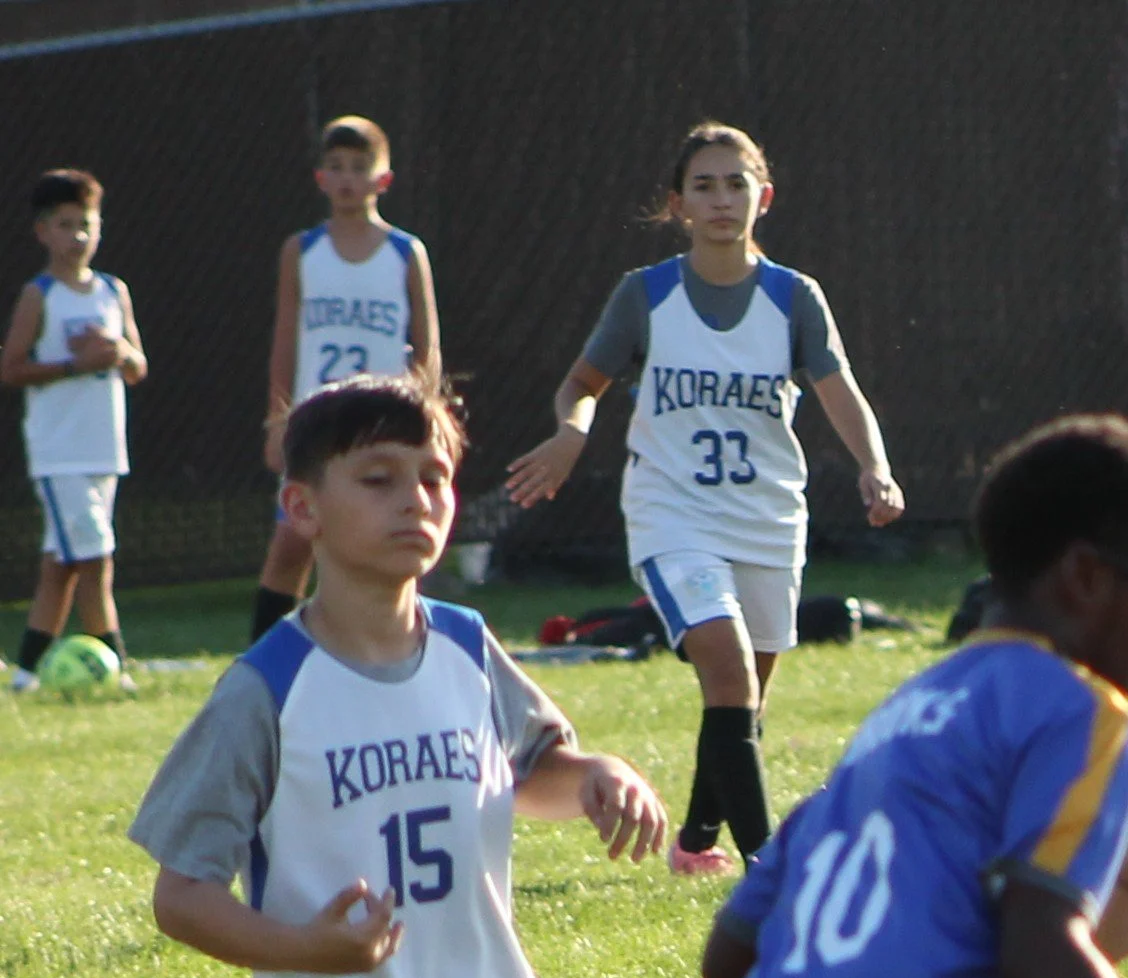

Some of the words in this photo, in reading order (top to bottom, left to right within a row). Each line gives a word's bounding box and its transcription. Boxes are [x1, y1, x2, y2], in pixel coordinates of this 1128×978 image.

[318, 344, 368, 384] 23
[653, 366, 787, 418] KORAES
[692, 430, 757, 486] 33
[325, 728, 482, 809] KORAES
[379, 805, 454, 908] 15
[781, 810, 895, 974] 10
